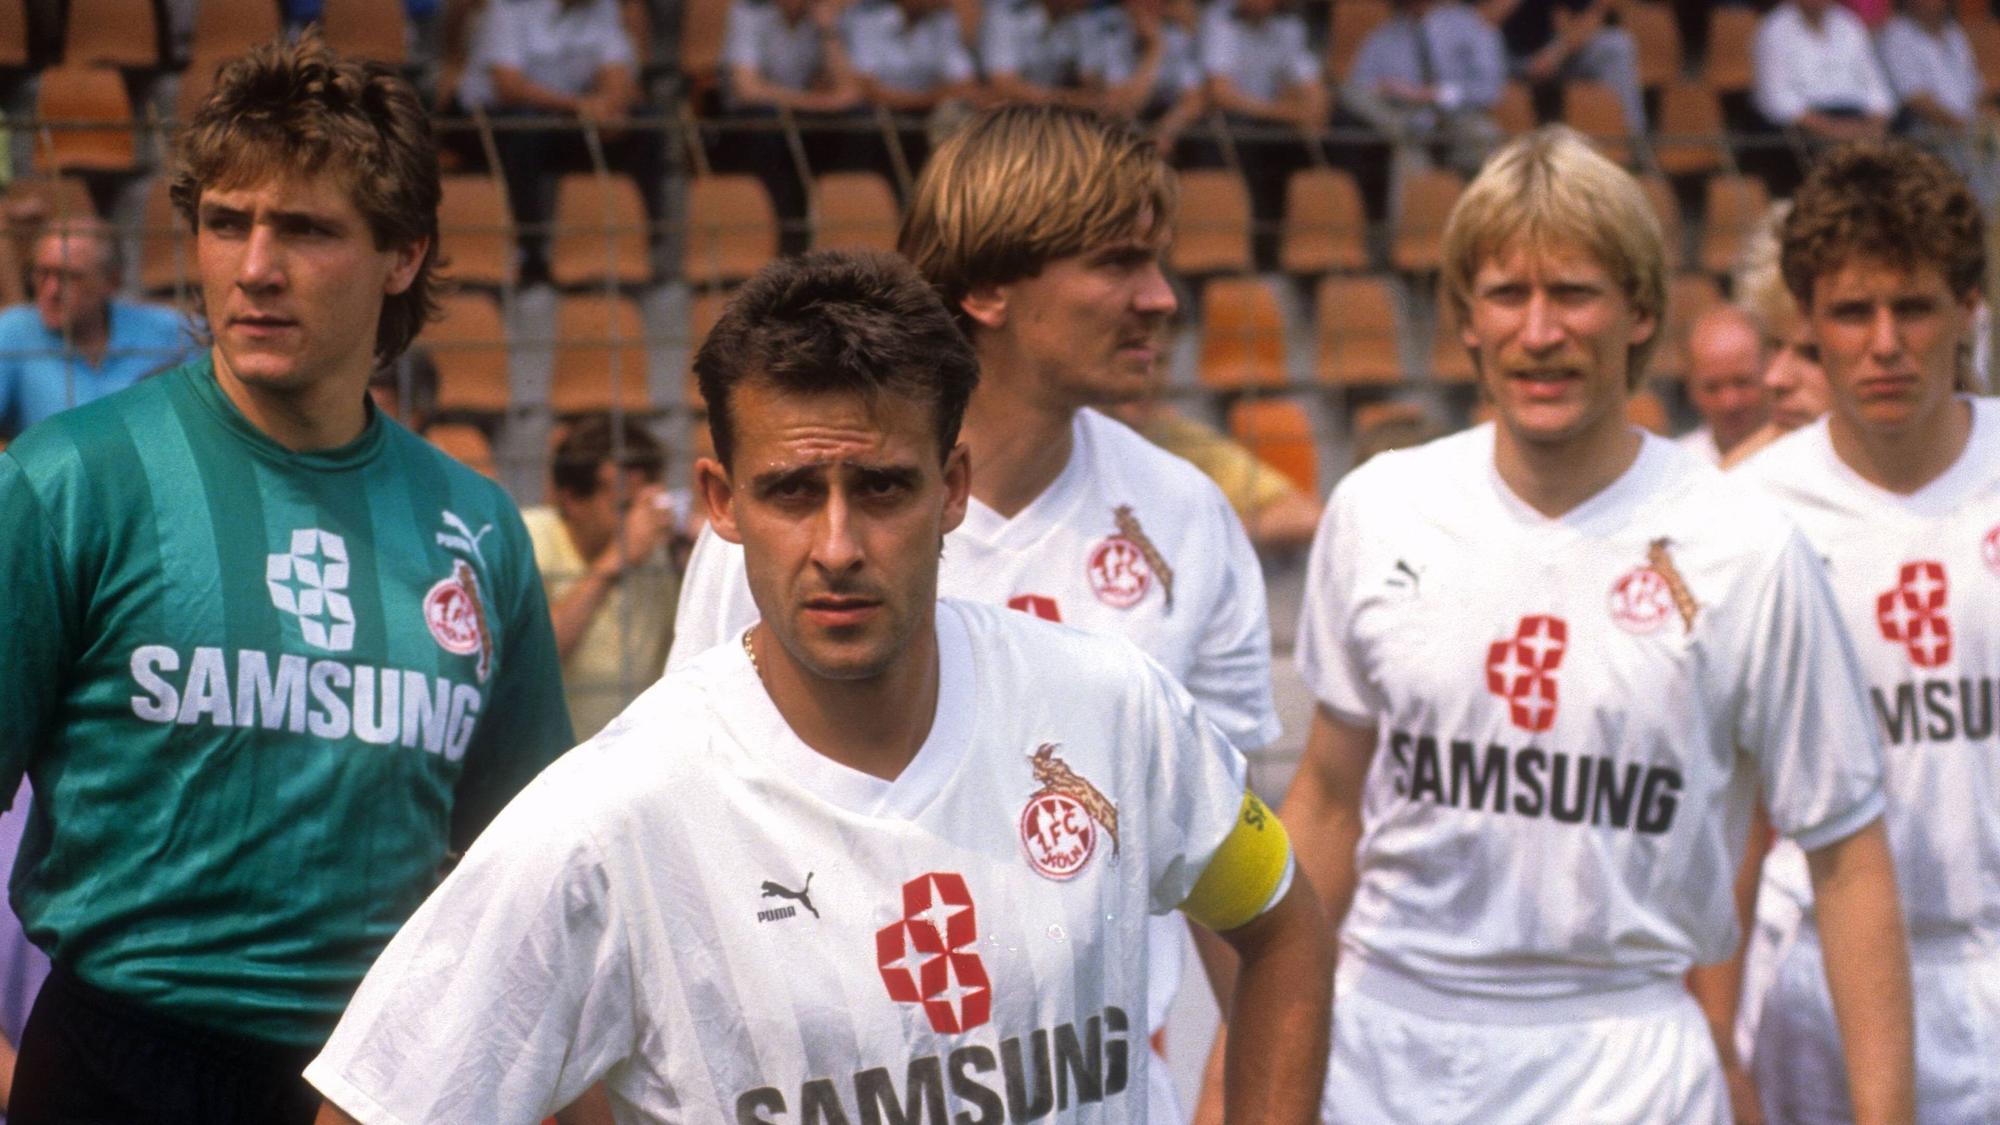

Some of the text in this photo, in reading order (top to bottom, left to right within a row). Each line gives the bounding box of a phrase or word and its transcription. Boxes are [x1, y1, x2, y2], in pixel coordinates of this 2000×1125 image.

[130, 645, 481, 762] SAMSUNG
[1870, 677, 2000, 745] MSU
[1390, 730, 1684, 834] SAMSUNG
[757, 905, 796, 923] PUMA
